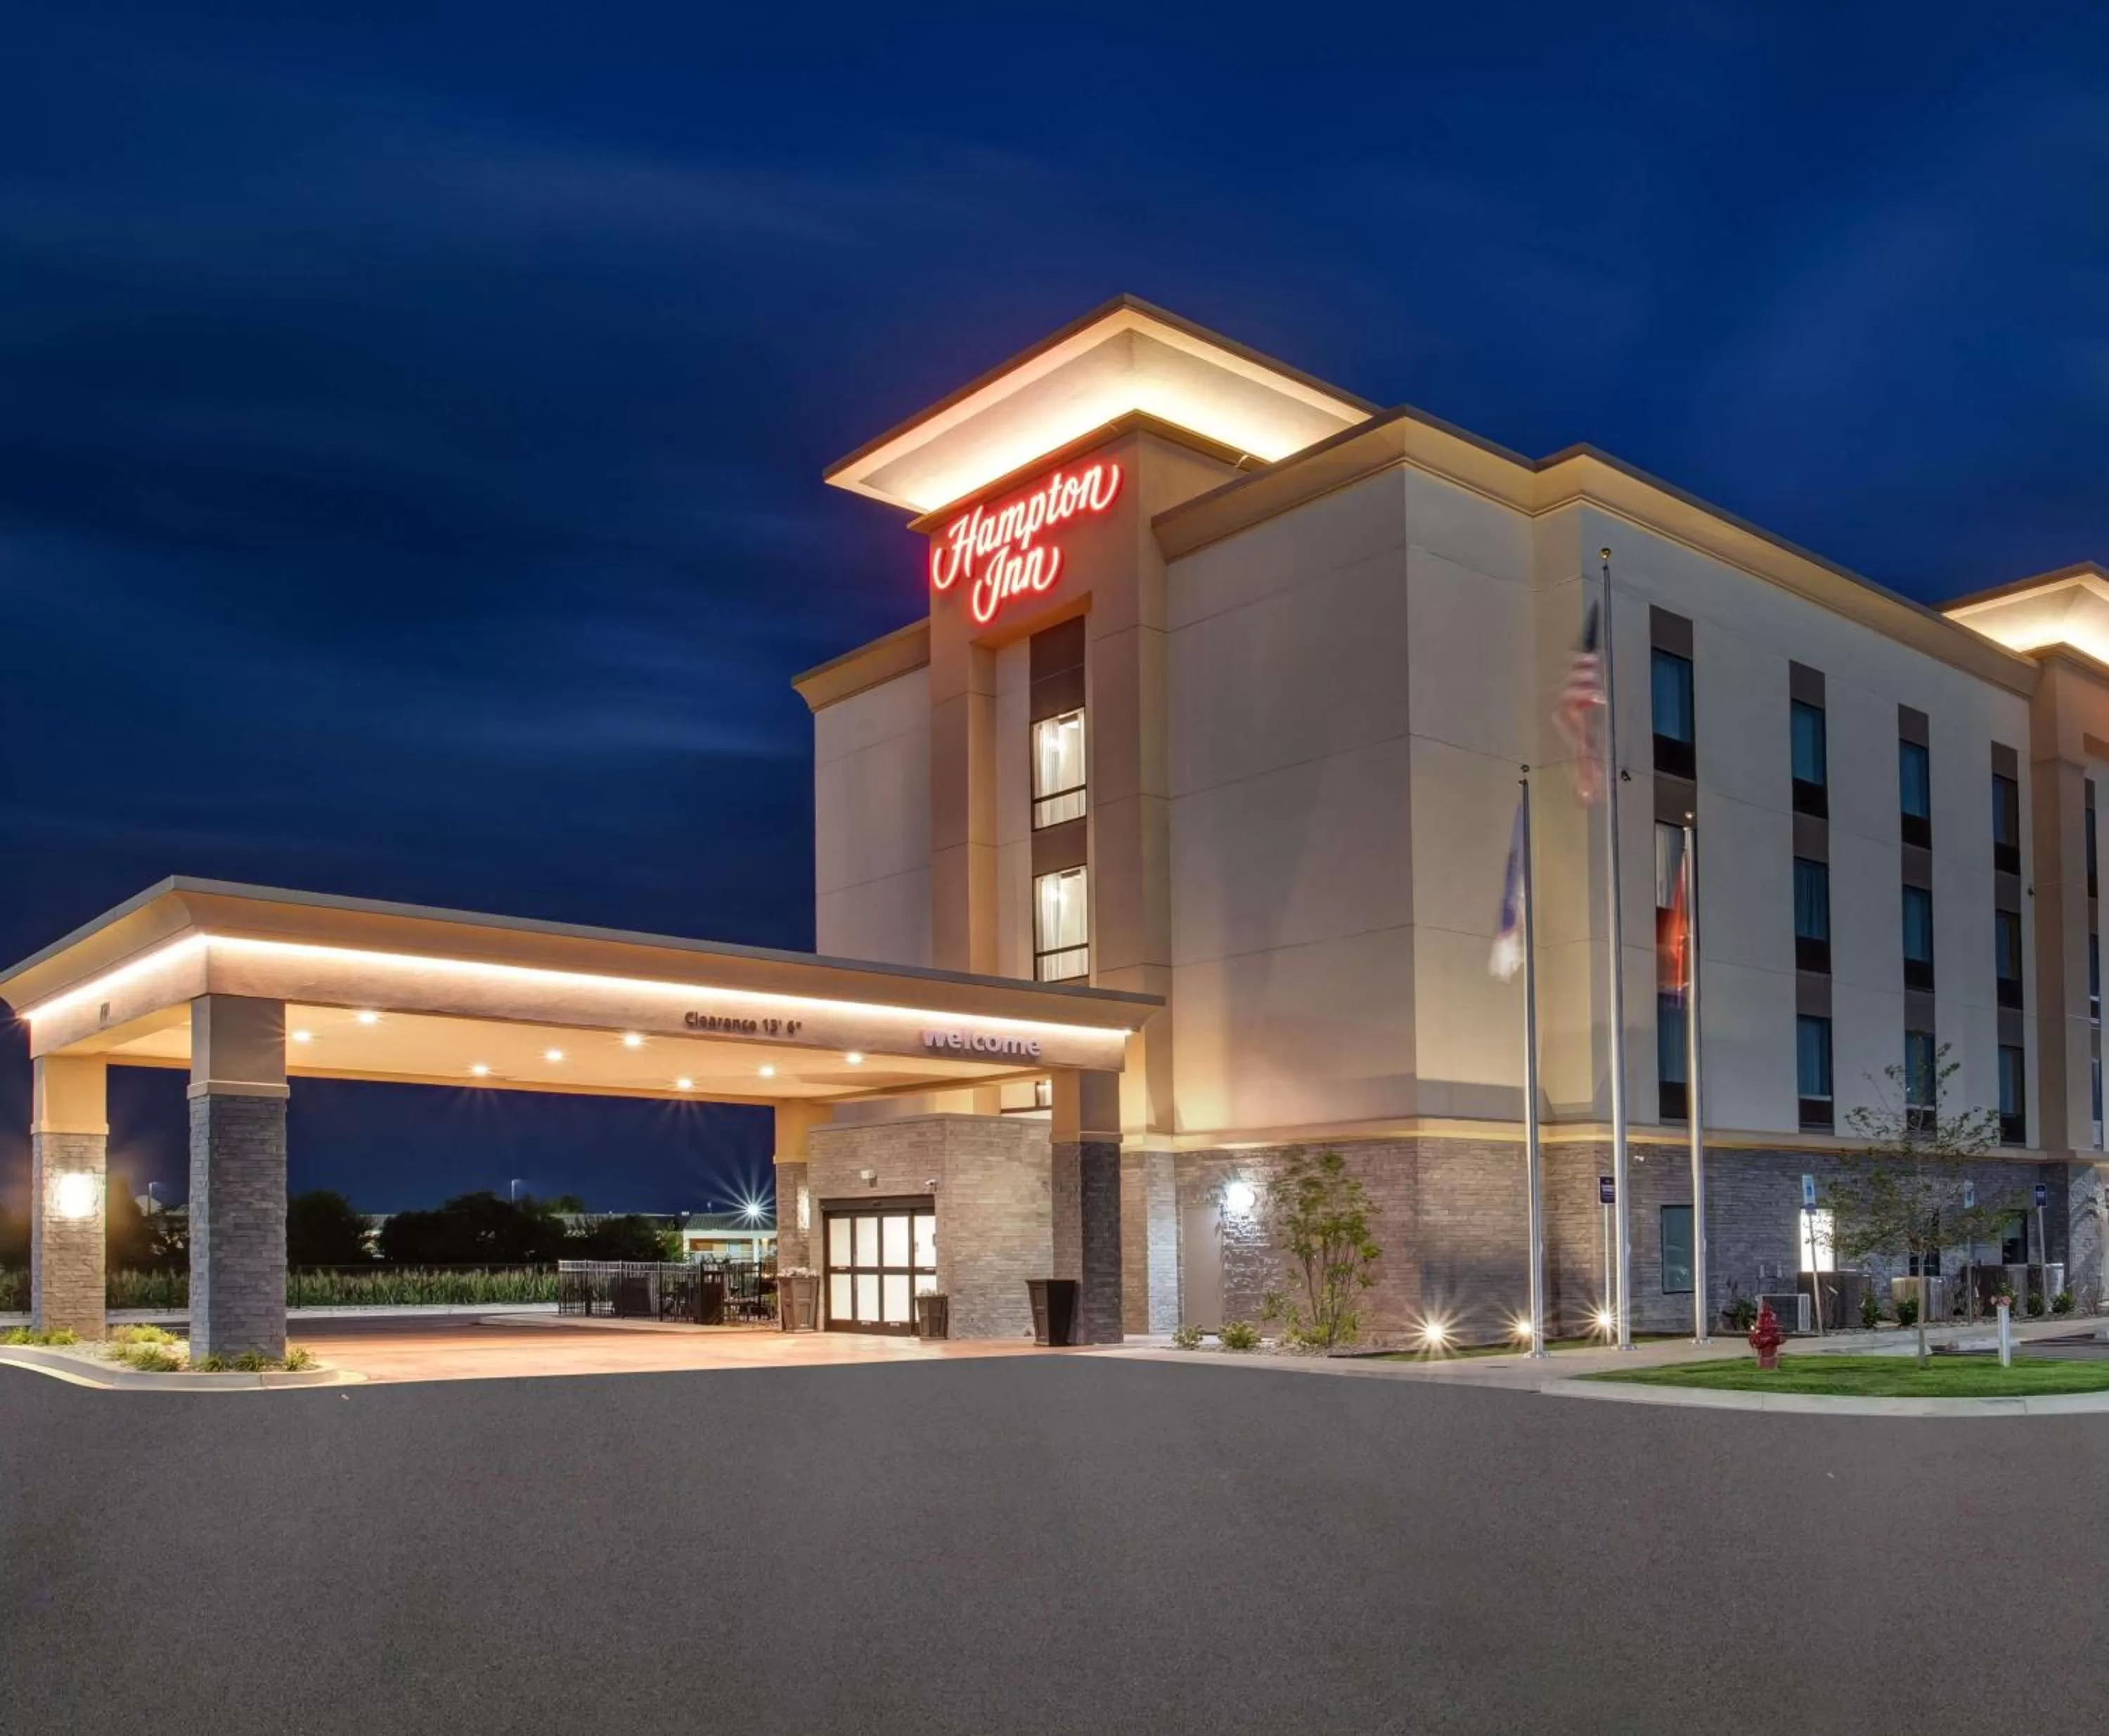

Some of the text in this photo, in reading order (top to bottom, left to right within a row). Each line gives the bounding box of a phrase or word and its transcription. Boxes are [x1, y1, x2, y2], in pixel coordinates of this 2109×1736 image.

[933, 464, 1120, 590] Hampton
[972, 545, 1059, 622] Inn
[684, 1011, 757, 1032] Clearance
[921, 1028, 1041, 1056] welcome
